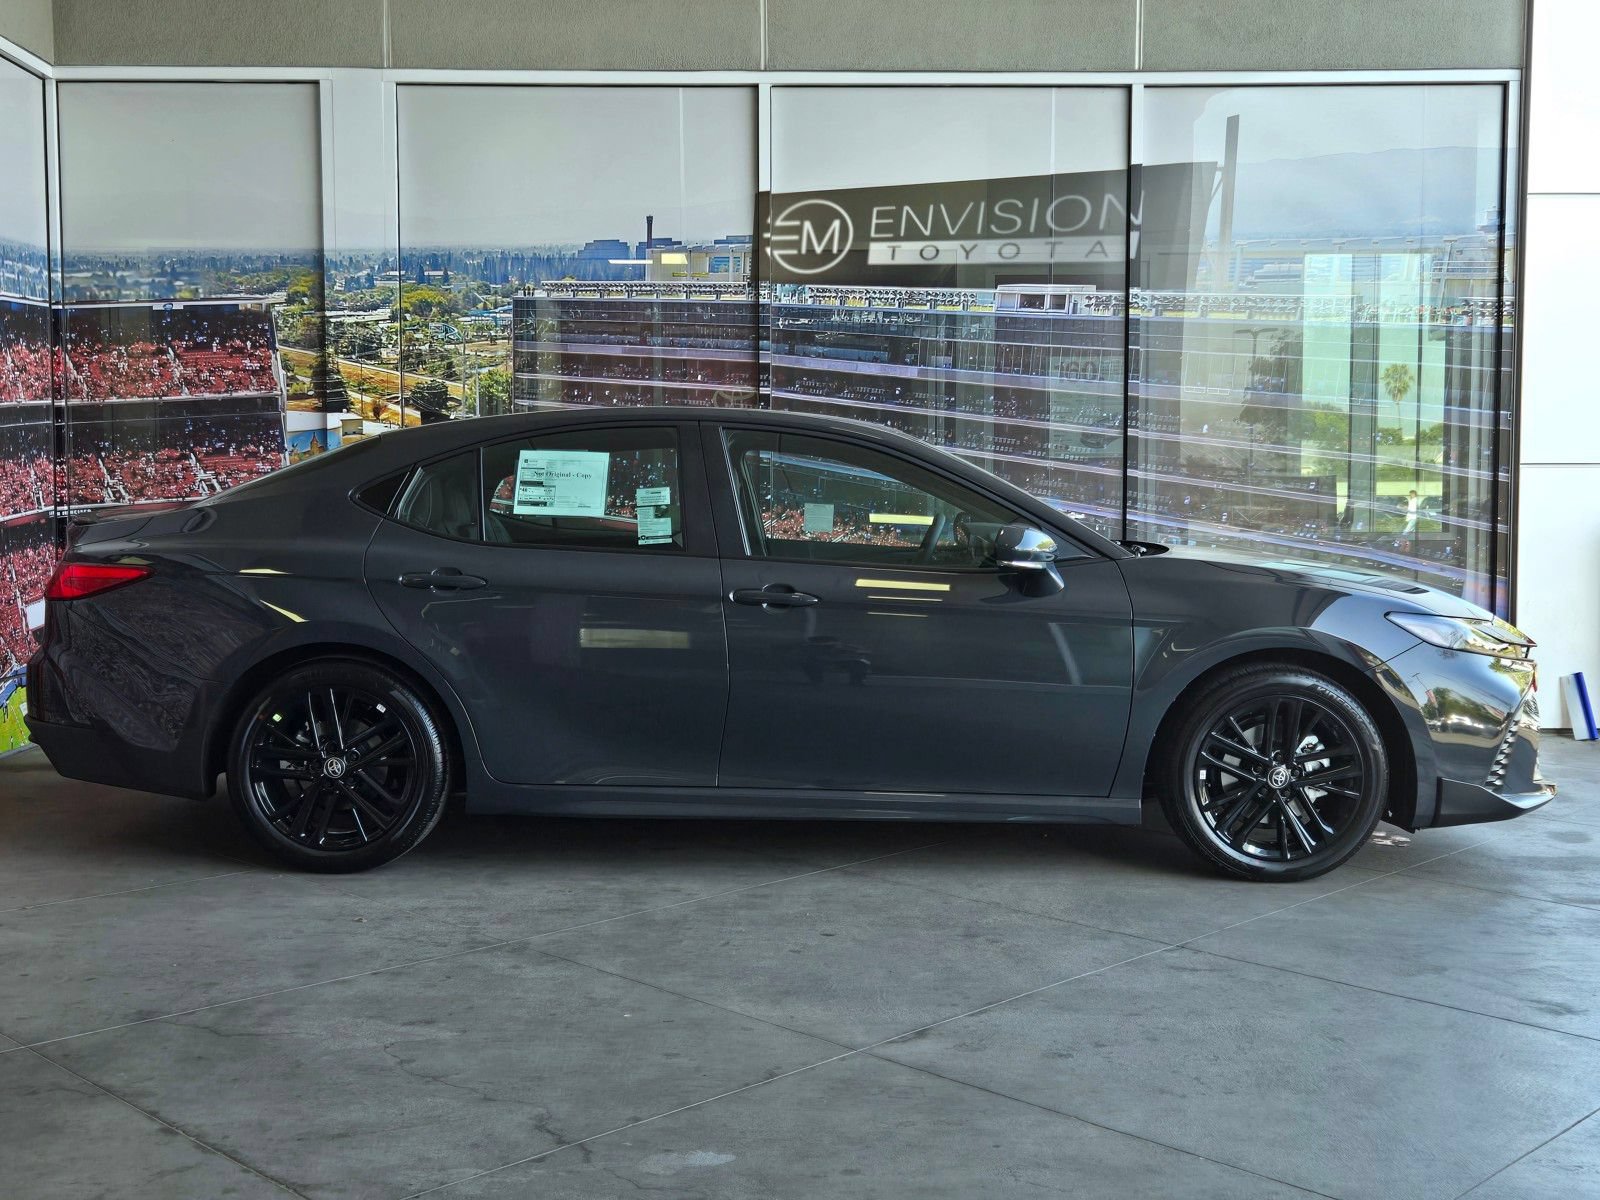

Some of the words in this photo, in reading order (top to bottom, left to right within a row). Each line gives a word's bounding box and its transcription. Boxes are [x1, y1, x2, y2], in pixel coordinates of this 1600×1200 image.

[869, 190, 1145, 238] ENVISION
[886, 238, 1110, 261] TOYOTA
[546, 471, 571, 479] Original
[576, 472, 592, 480] Copy
